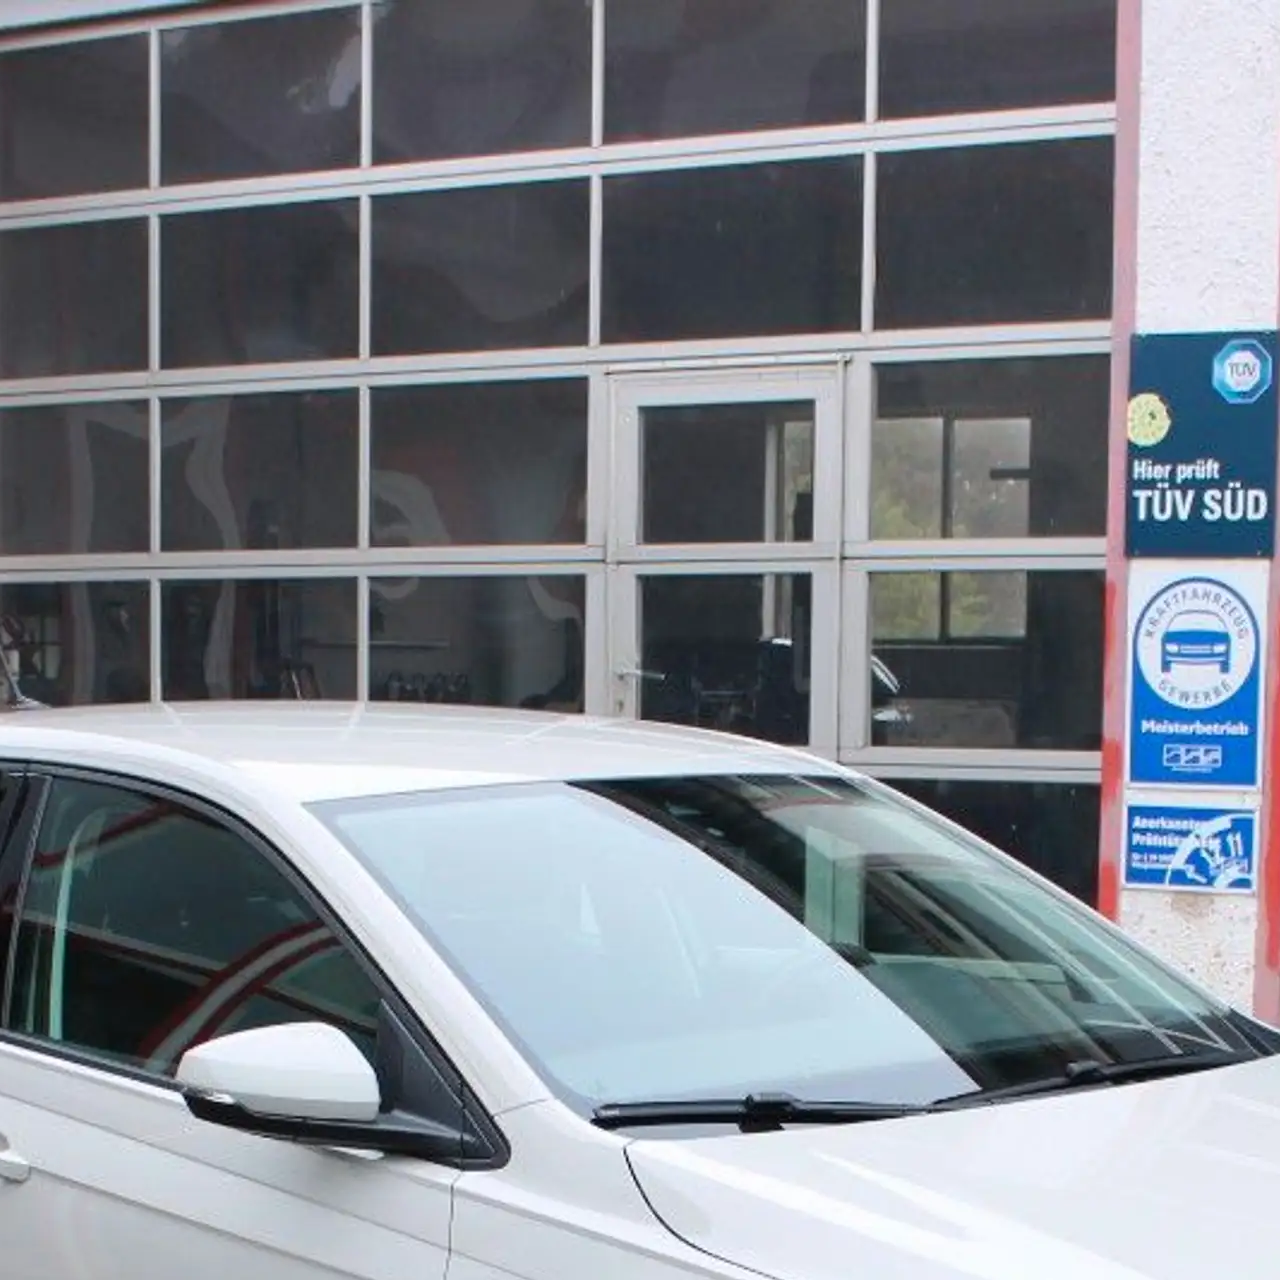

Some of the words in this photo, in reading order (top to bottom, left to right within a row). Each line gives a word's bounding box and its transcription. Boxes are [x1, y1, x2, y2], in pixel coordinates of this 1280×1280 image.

[1133, 459, 1170, 479] Hier
[1176, 459, 1220, 484] prüft
[1133, 483, 1195, 522] TÜV
[1202, 482, 1268, 522] SÜD
[1141, 719, 1249, 736] Meisterbetrieb
